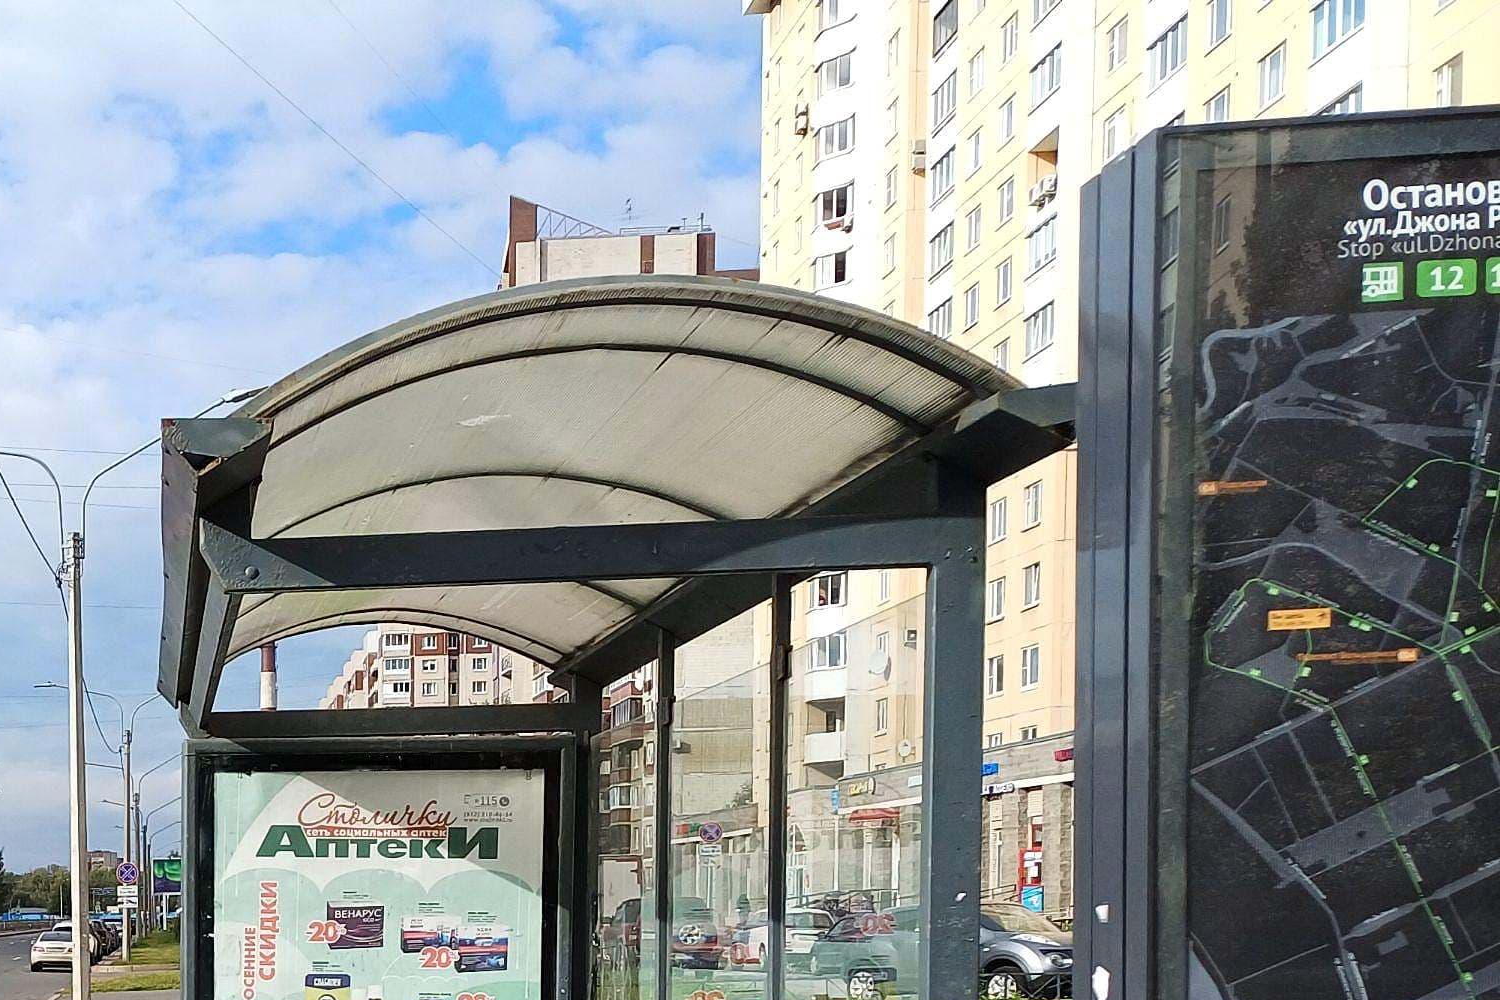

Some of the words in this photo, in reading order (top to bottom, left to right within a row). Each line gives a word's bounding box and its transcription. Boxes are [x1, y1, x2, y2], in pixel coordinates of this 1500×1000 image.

[1337, 239, 1384, 260] Stop
[1430, 265, 1464, 292] 12
[298, 793, 456, 827] Столички
[306, 829, 331, 837] сеть
[333, 829, 409, 839] социальных
[411, 829, 447, 838] аптек
[334, 908, 383, 919] ВЕНАРУС
[259, 882, 280, 980] СКИДКИ
[243, 927, 256, 1000] ОСЕННИЕ
